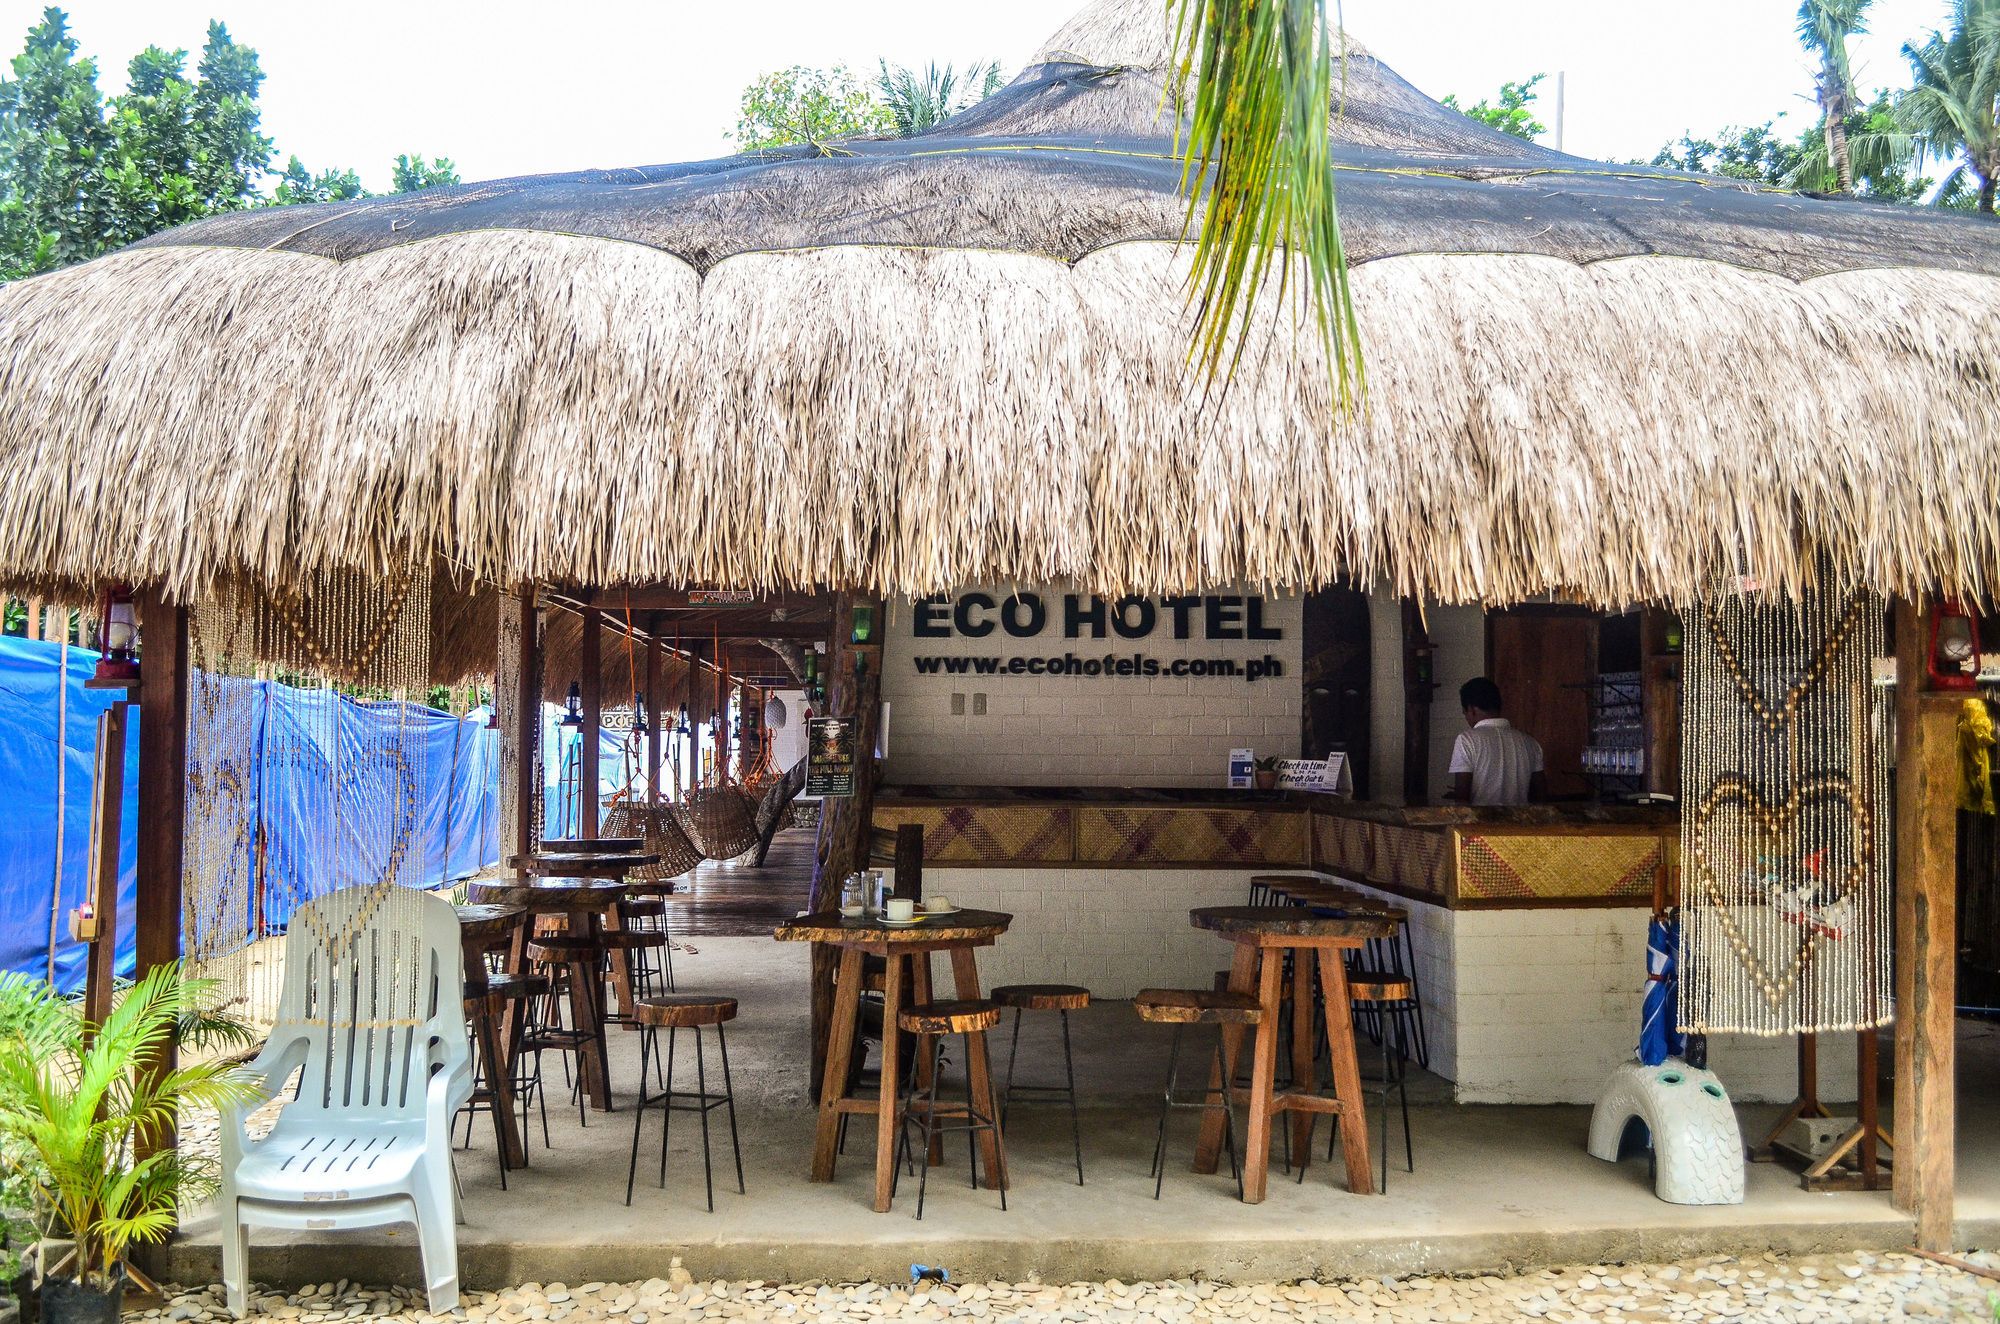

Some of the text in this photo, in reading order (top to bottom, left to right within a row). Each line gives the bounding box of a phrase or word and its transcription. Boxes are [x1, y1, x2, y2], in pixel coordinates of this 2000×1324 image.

[914, 593, 1282, 640] ECO HOTEL
[914, 652, 1283, 682] www.ecohotels.com.ph
